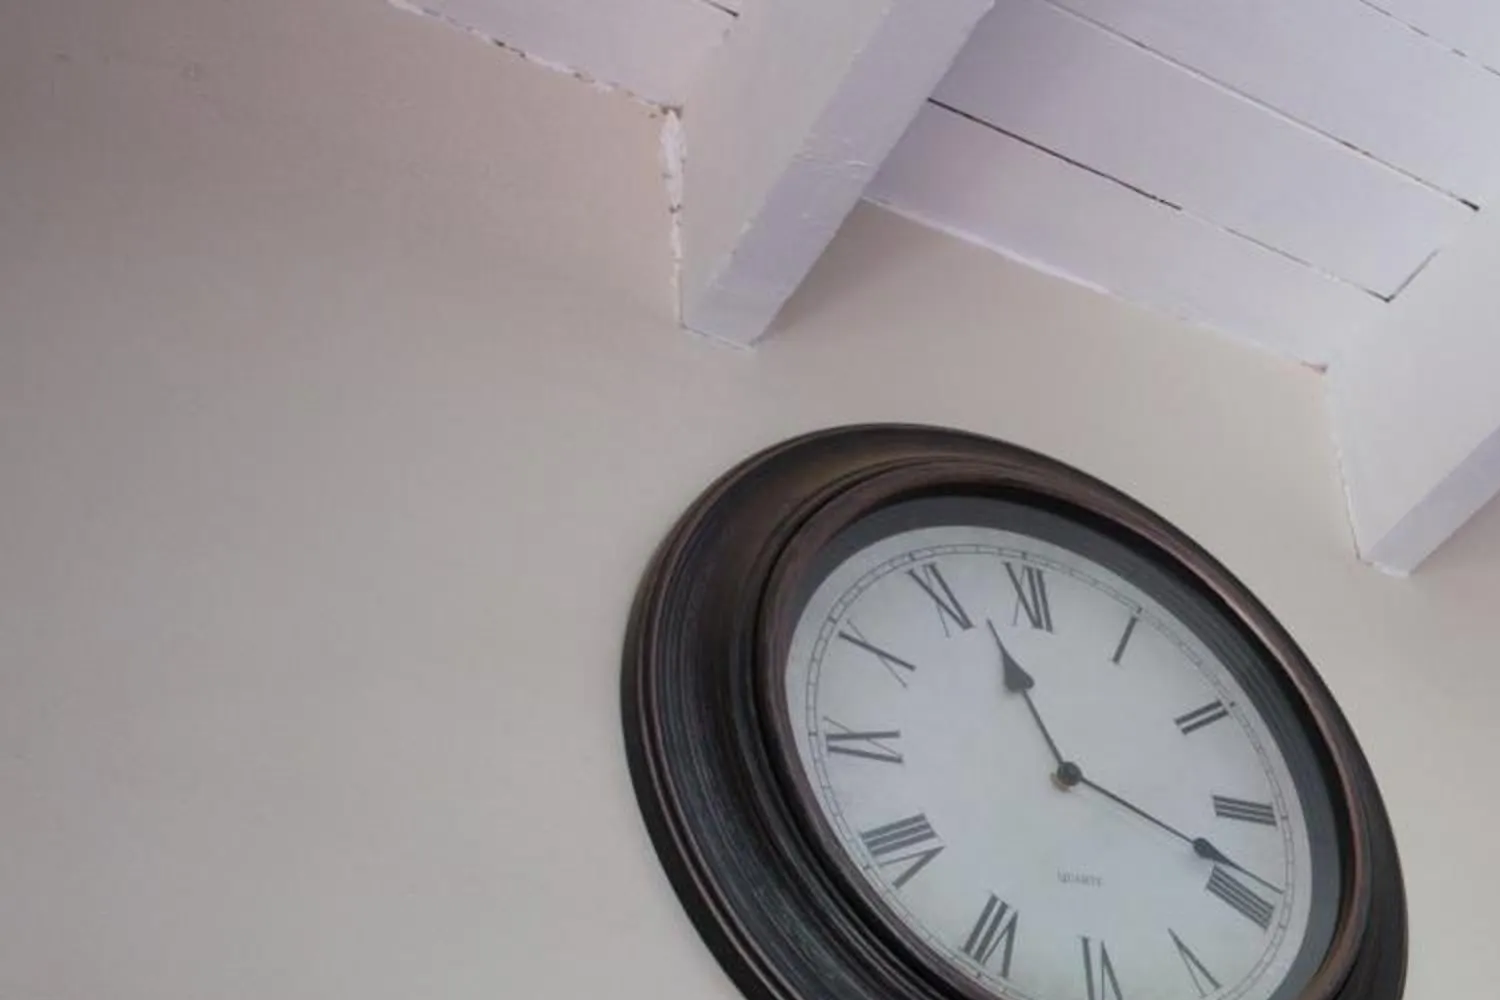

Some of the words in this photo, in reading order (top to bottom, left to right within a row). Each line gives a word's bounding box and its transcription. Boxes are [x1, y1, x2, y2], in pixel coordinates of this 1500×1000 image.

[904, 562, 976, 637] XI
[1004, 560, 1053, 633] XII
[837, 618, 917, 688] X
[823, 716, 904, 764] IX
[1174, 700, 1230, 736] II
[1212, 795, 1278, 827] III
[860, 813, 945, 890] VIII
[963, 893, 1019, 979] VII
[1167, 928, 1221, 999] V
